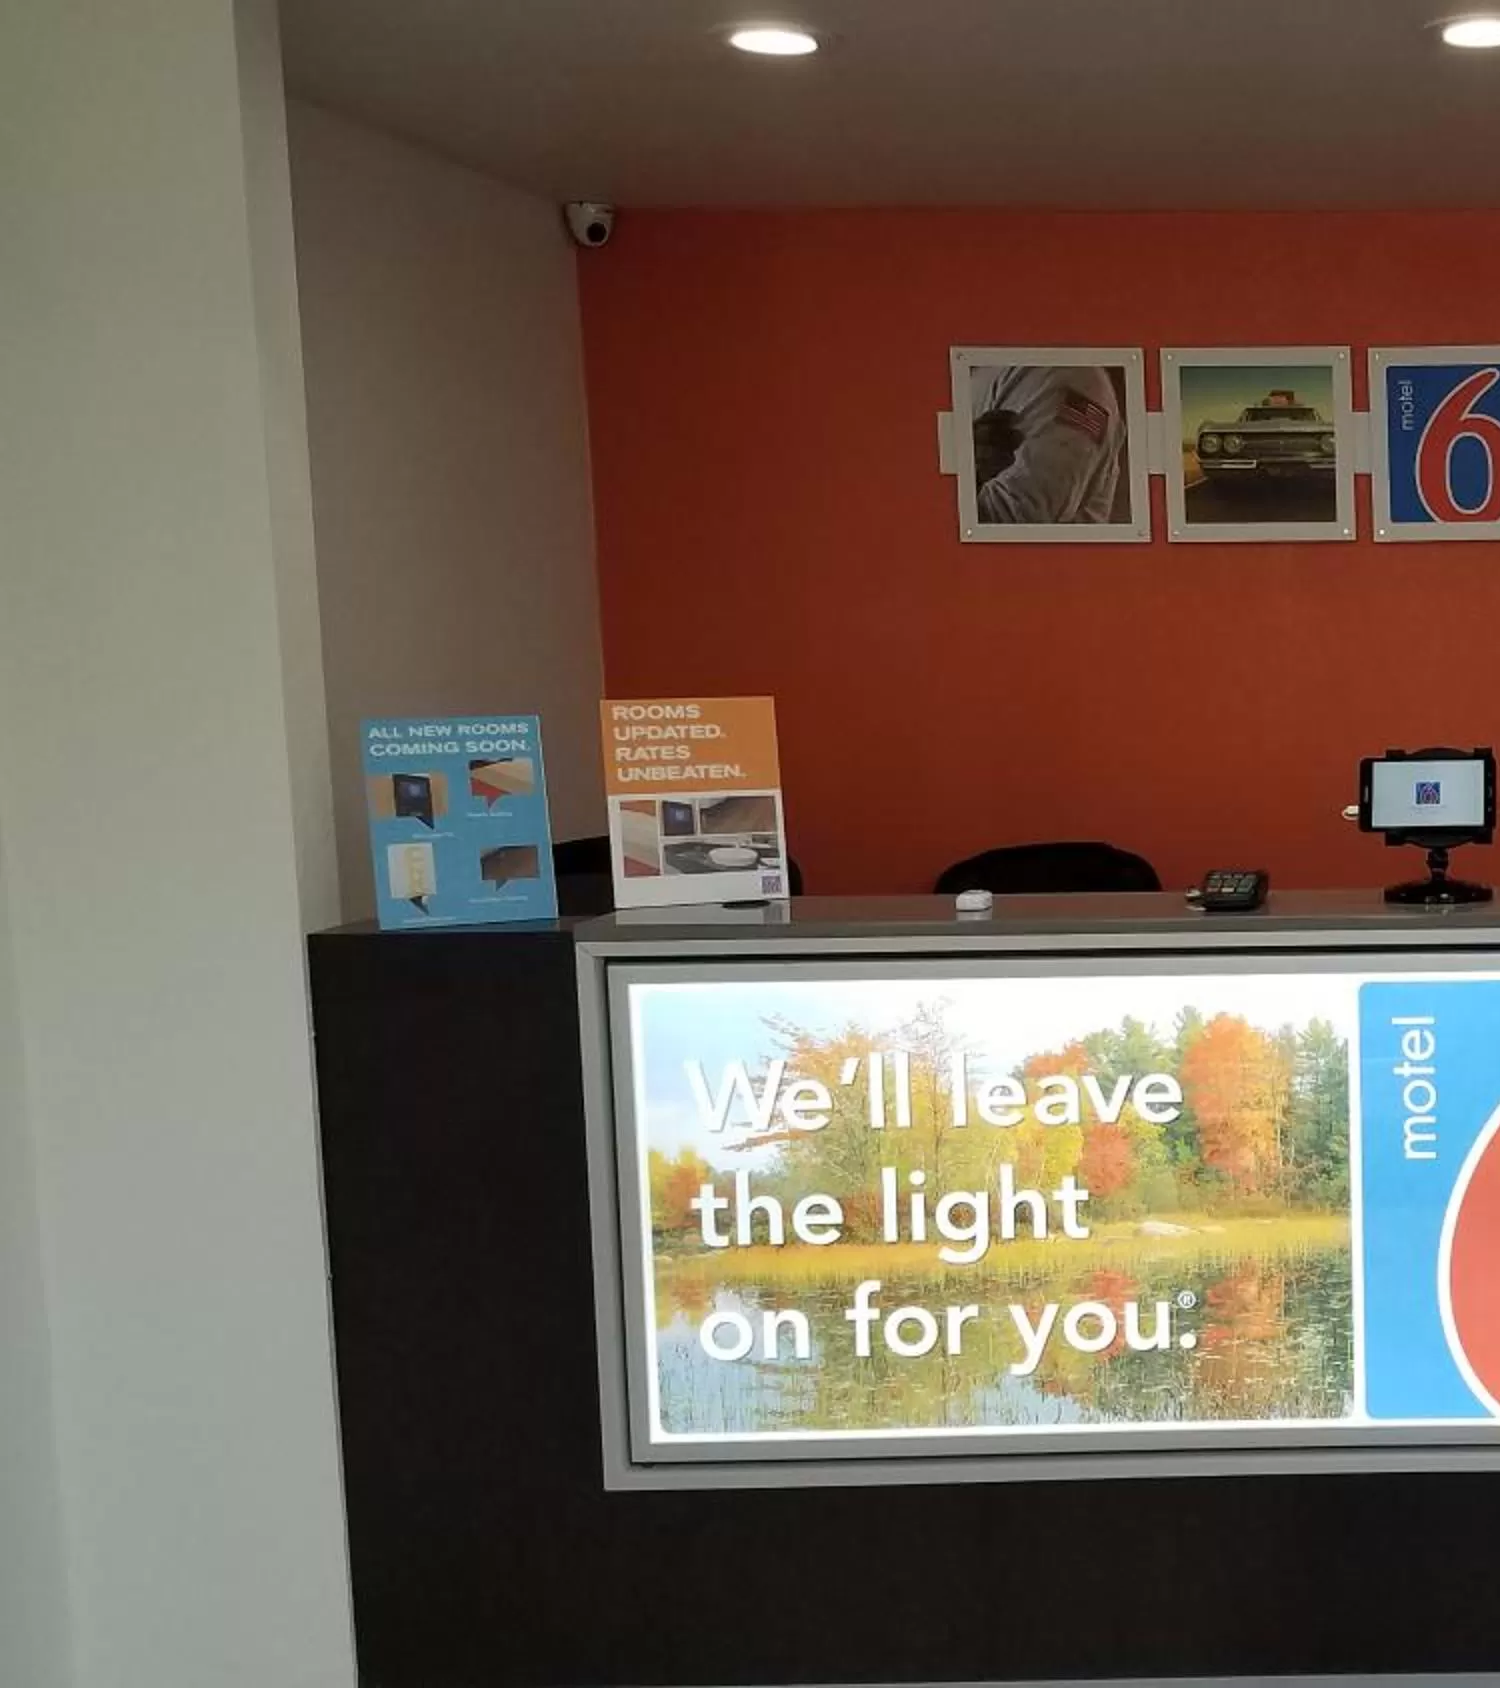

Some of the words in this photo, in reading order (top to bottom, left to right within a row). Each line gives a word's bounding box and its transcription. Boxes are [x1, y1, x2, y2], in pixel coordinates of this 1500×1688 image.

[1398, 379, 1415, 431] motel
[611, 704, 702, 720] ROOMS
[368, 727, 402, 739] ALL
[409, 725, 451, 737] NEW
[457, 723, 529, 736] ROOMS
[613, 724, 727, 741] UPDATED.
[369, 741, 460, 757] COMING
[465, 739, 531, 753] SOON.
[615, 745, 691, 761] RATES
[617, 764, 747, 782] UNBEATEN.
[685, 1051, 912, 1133] We'll
[951, 1051, 1184, 1128] leave
[1392, 1015, 1437, 1160] motel
[692, 1170, 843, 1248] the
[881, 1163, 1090, 1265] light
[699, 1304, 811, 1362] on
[846, 1280, 978, 1358] for
